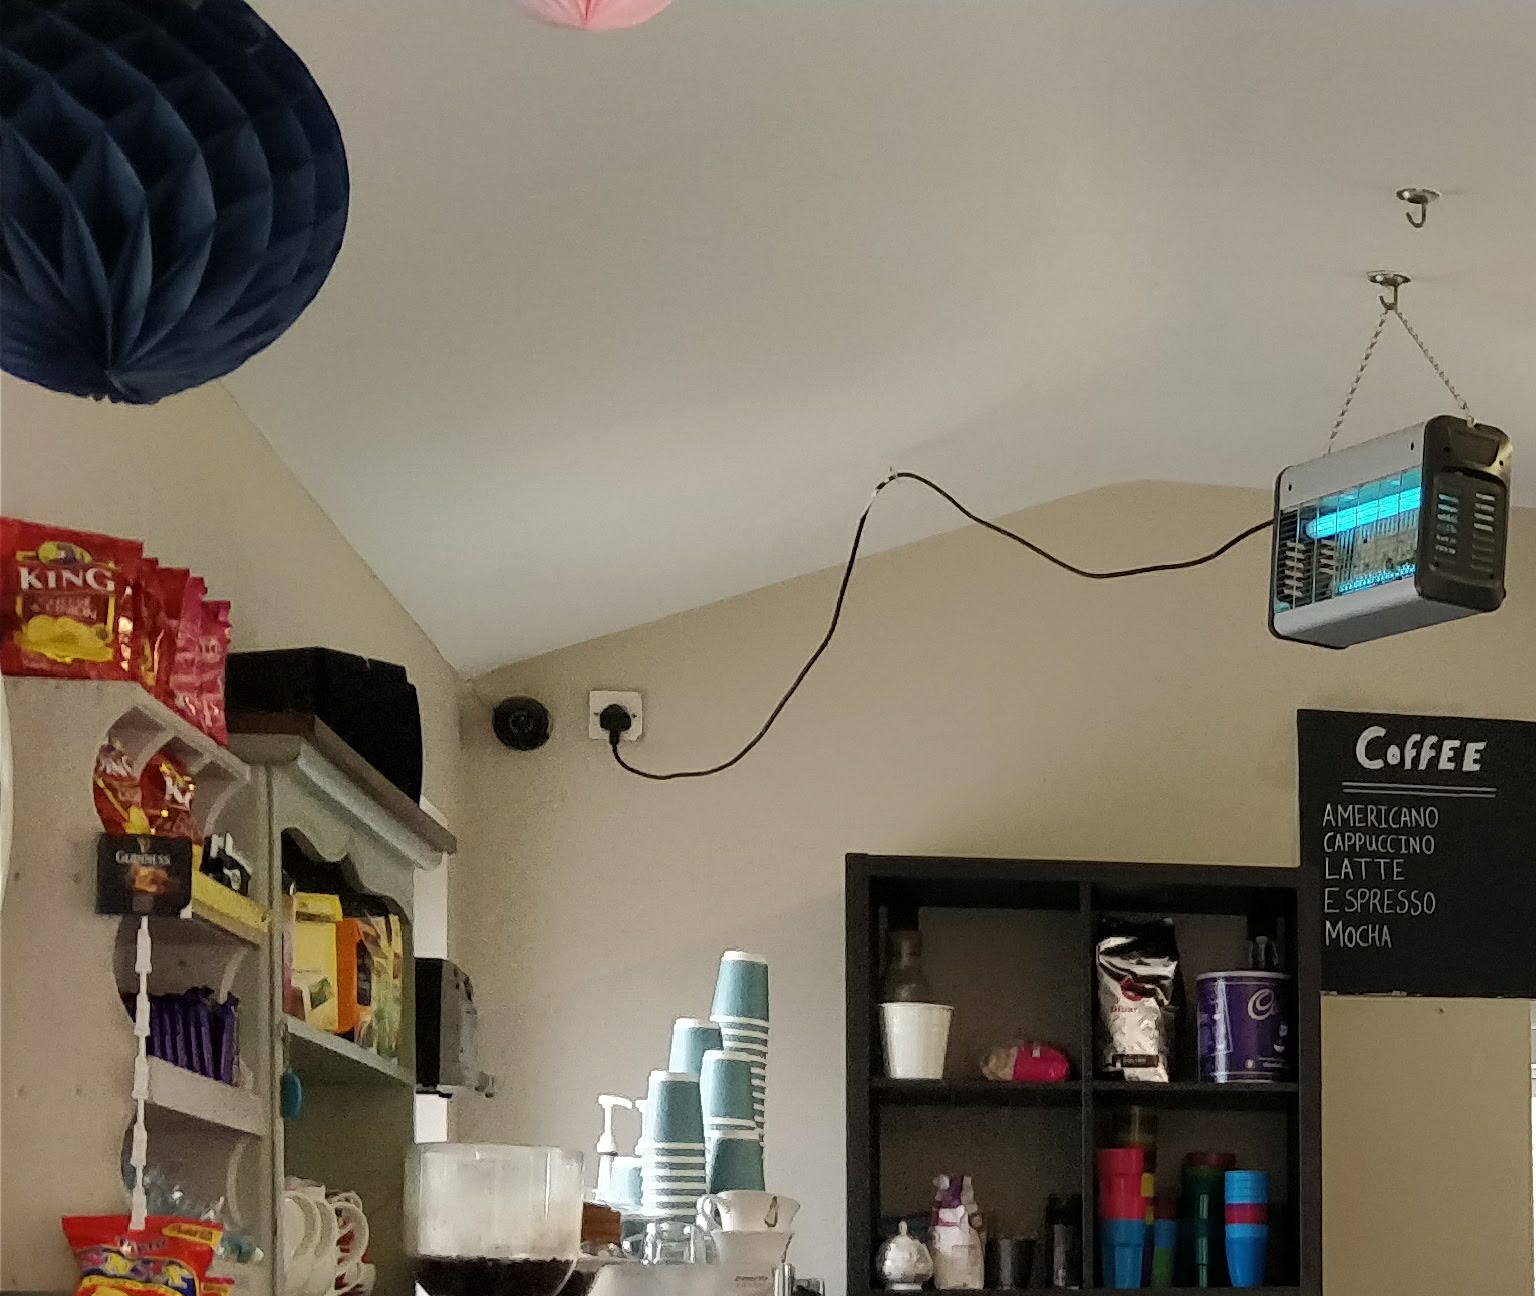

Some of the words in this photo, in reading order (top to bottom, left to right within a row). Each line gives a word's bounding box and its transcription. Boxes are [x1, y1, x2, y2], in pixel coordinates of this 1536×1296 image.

[18, 566, 116, 592] KING
[1322, 802, 1440, 829] AMERICANO
[1323, 831, 1435, 855] CAPPUCCINO
[1325, 857, 1405, 881] LATTE
[1324, 887, 1436, 916] ESPRESSO
[1325, 919, 1392, 948] MOCHA
